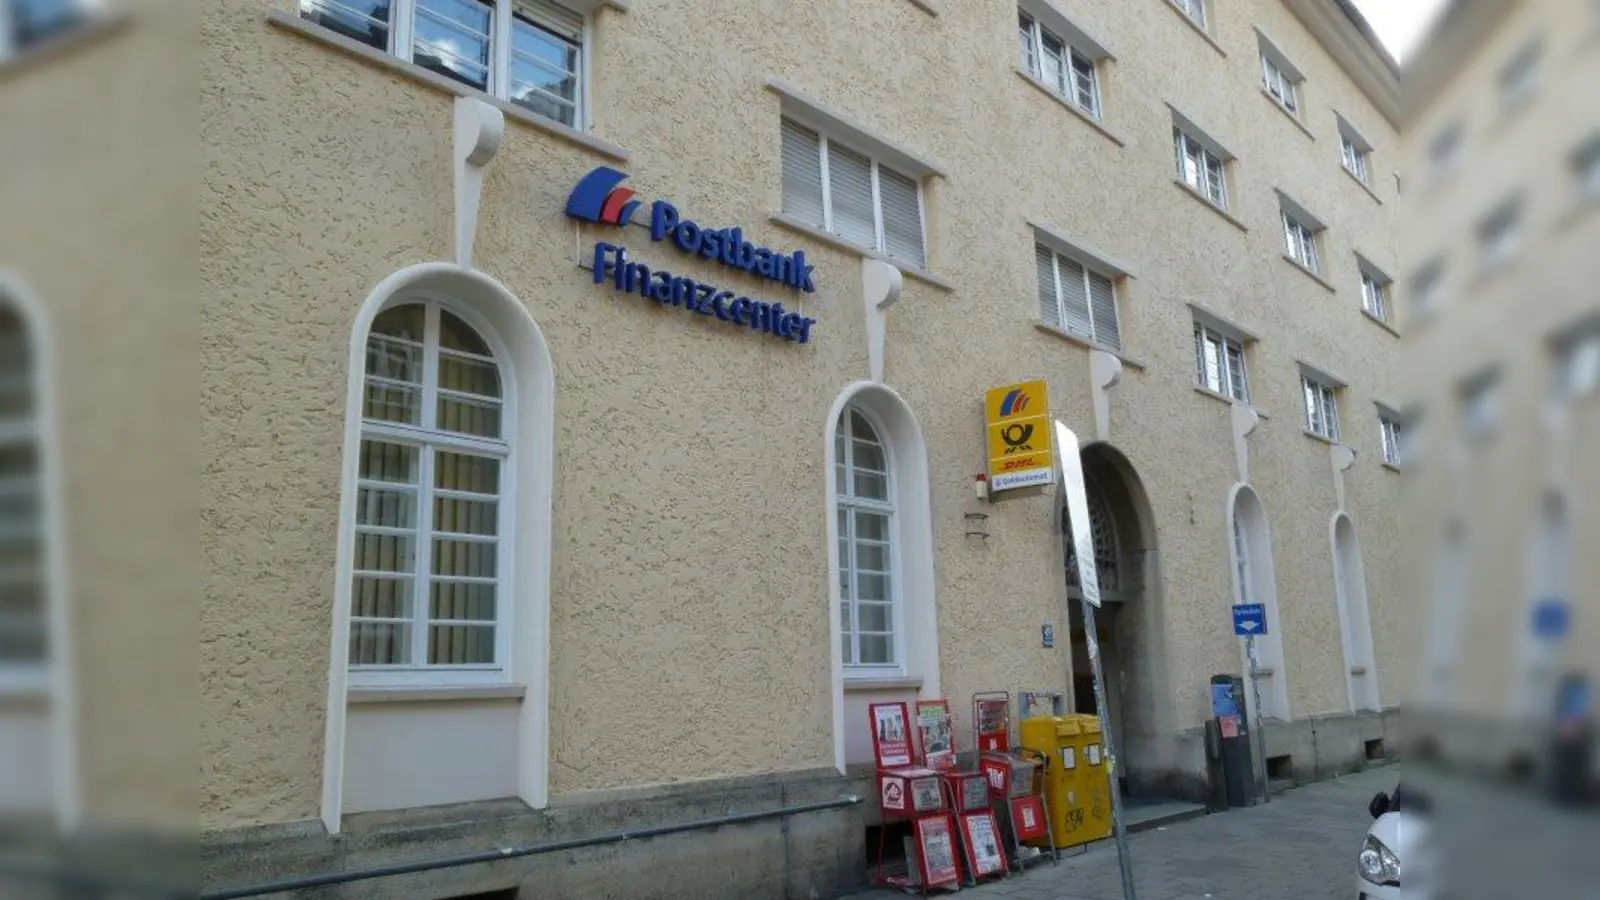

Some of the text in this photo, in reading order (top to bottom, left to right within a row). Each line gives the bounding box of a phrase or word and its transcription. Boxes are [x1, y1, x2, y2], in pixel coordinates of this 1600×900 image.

[593, 242, 816, 344] Finanzcenter
[651, 200, 815, 293] Postbank
[1003, 457, 1034, 469] DHL
